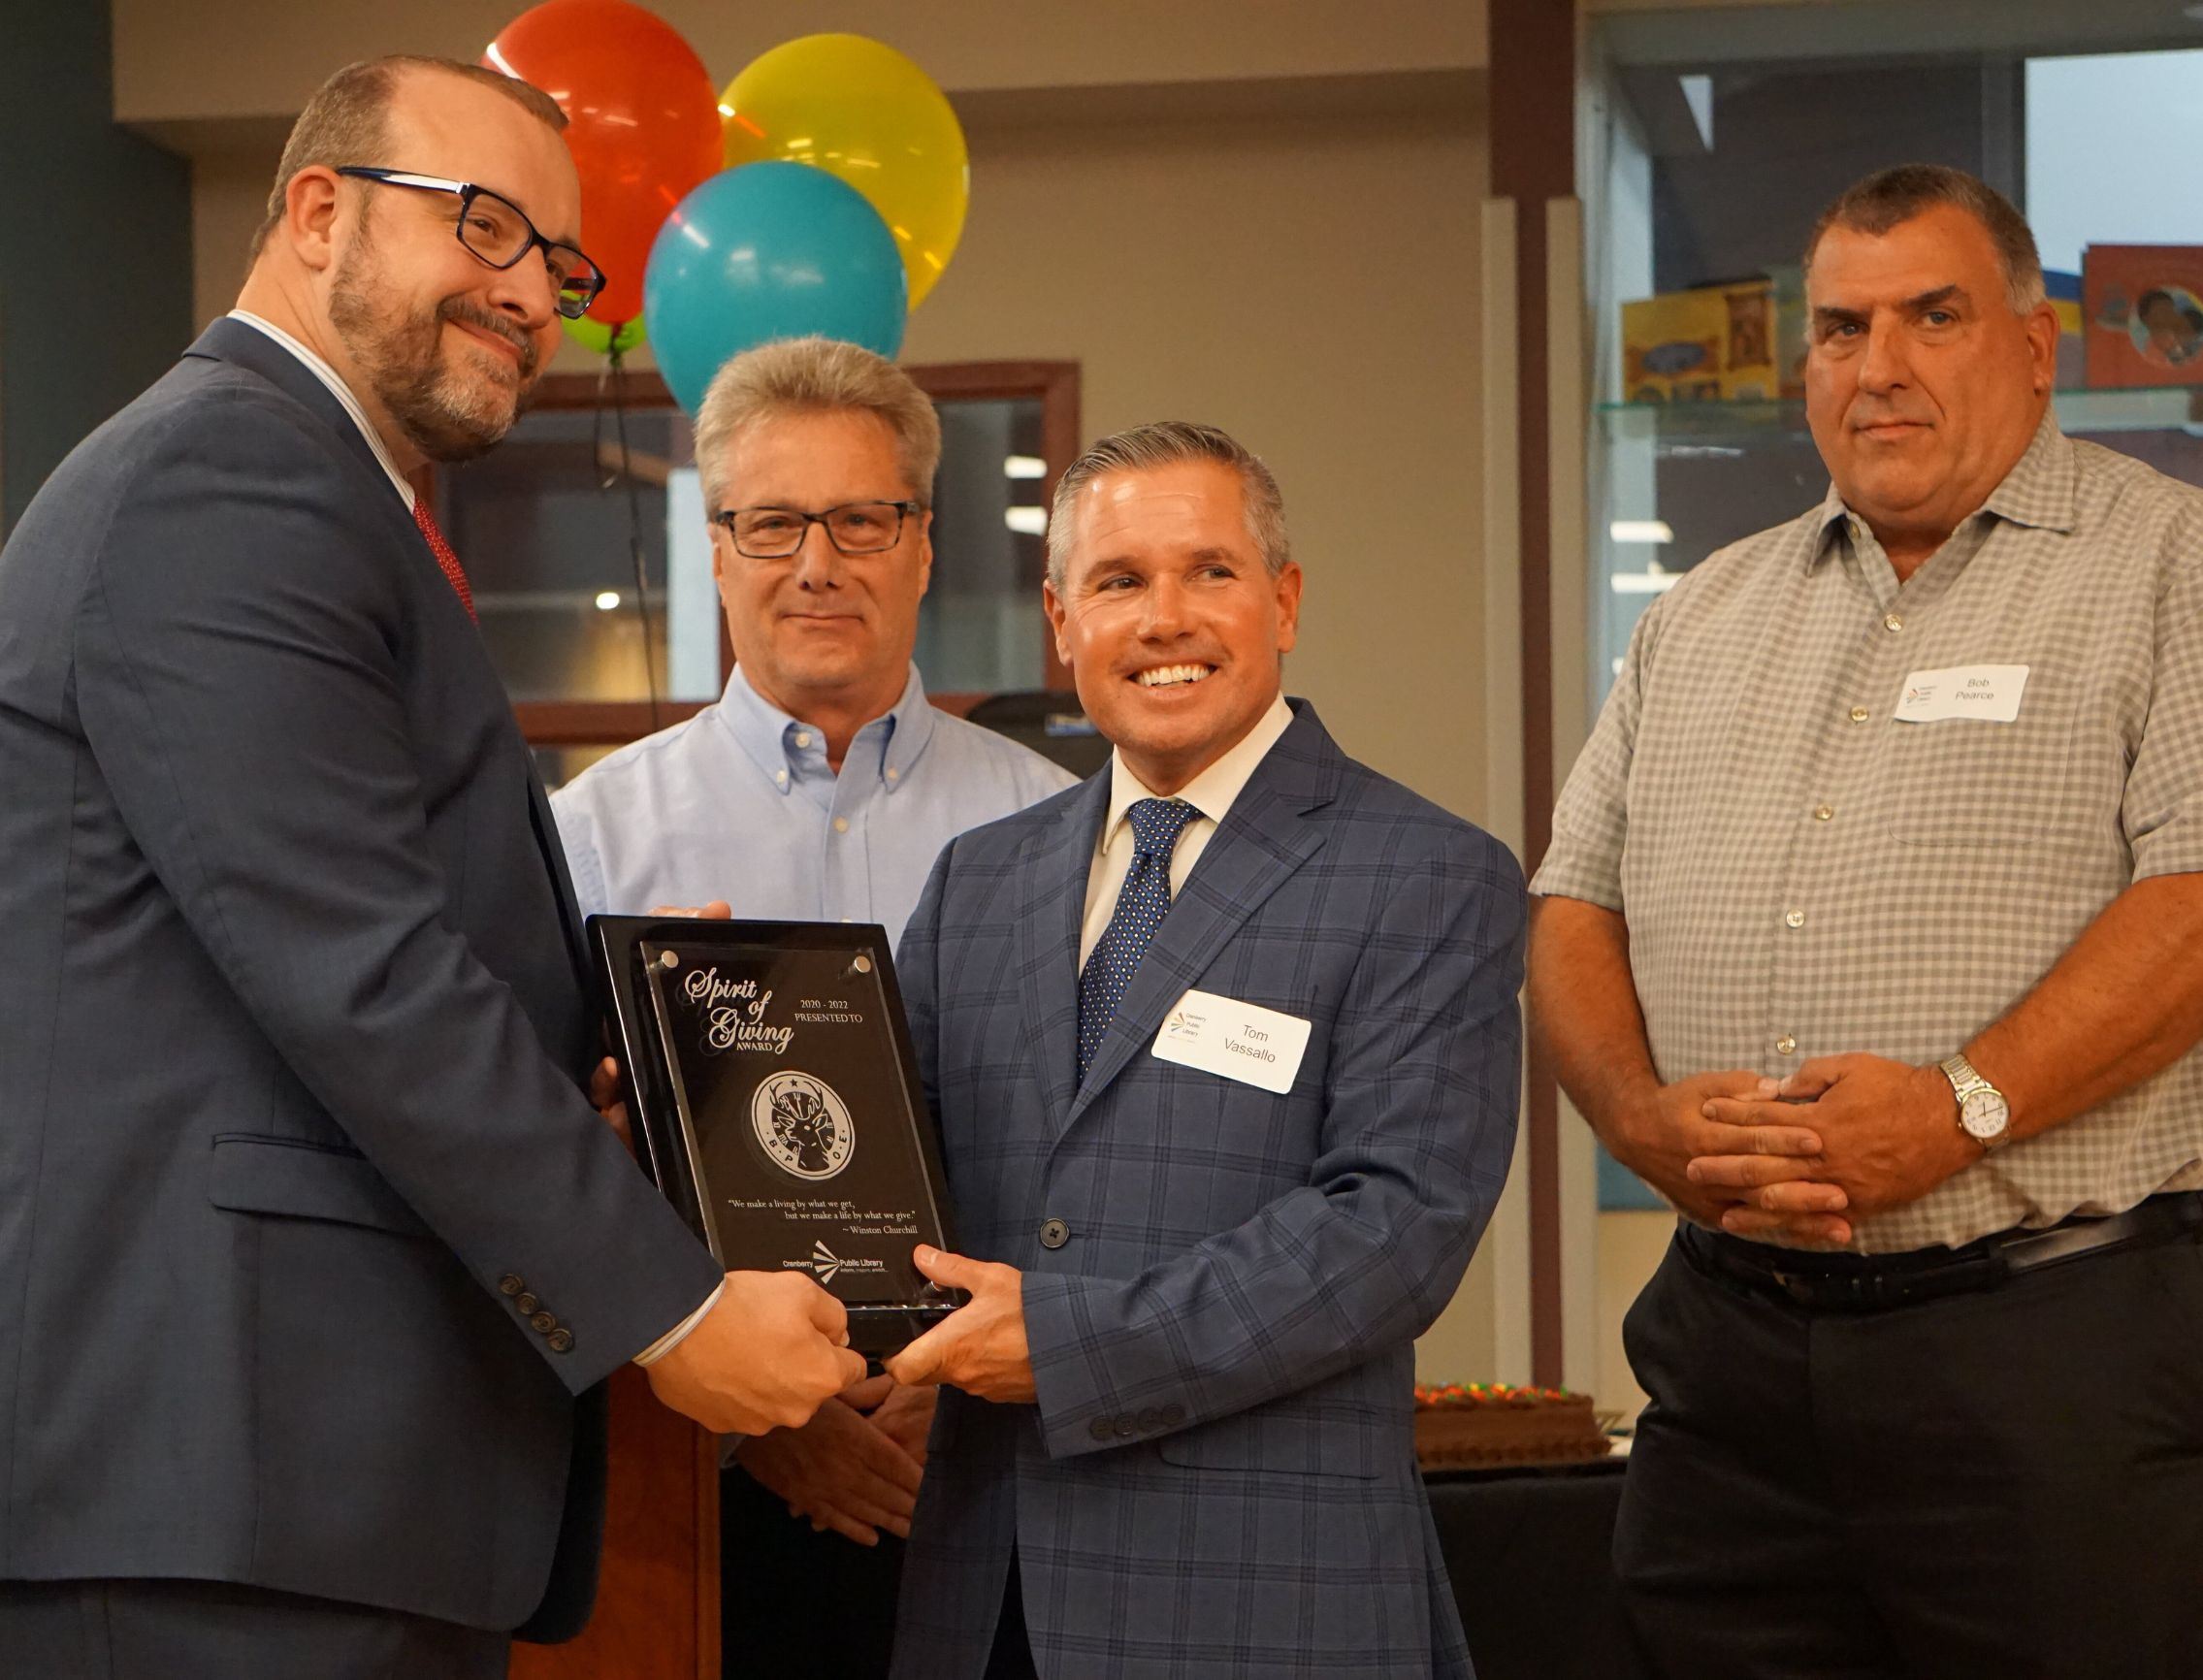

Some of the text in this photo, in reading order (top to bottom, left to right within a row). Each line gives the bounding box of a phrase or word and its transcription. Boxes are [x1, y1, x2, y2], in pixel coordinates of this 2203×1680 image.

[1967, 678, 1990, 688] Bob
[1955, 691, 1994, 700] Pearce
[684, 967, 758, 1009] Spirit
[748, 990, 772, 1025] of
[799, 999, 821, 1009] 2020
[828, 1000, 849, 1010] 2022
[794, 1013, 863, 1023] PRESENTED TO
[708, 1006, 794, 1054] Giving
[1243, 1024, 1269, 1042] Tom
[736, 1042, 773, 1051] AWARD
[1224, 1038, 1276, 1063] Vassallo
[747, 1199, 766, 1208] make
[774, 1199, 796, 1211] living
[796, 1199, 806, 1211] by
[807, 1199, 826, 1208] what
[840, 1201, 856, 1211] get,
[784, 1211, 797, 1219] but
[812, 1211, 832, 1219] make
[839, 1211, 852, 1219] life
[853, 1211, 862, 1222] by
[863, 1211, 882, 1219] what
[850, 1225, 882, 1234] Winston
[883, 1225, 918, 1234] Churchill
[783, 1260, 814, 1269] Cranberry
[860, 1259, 884, 1268] Library
